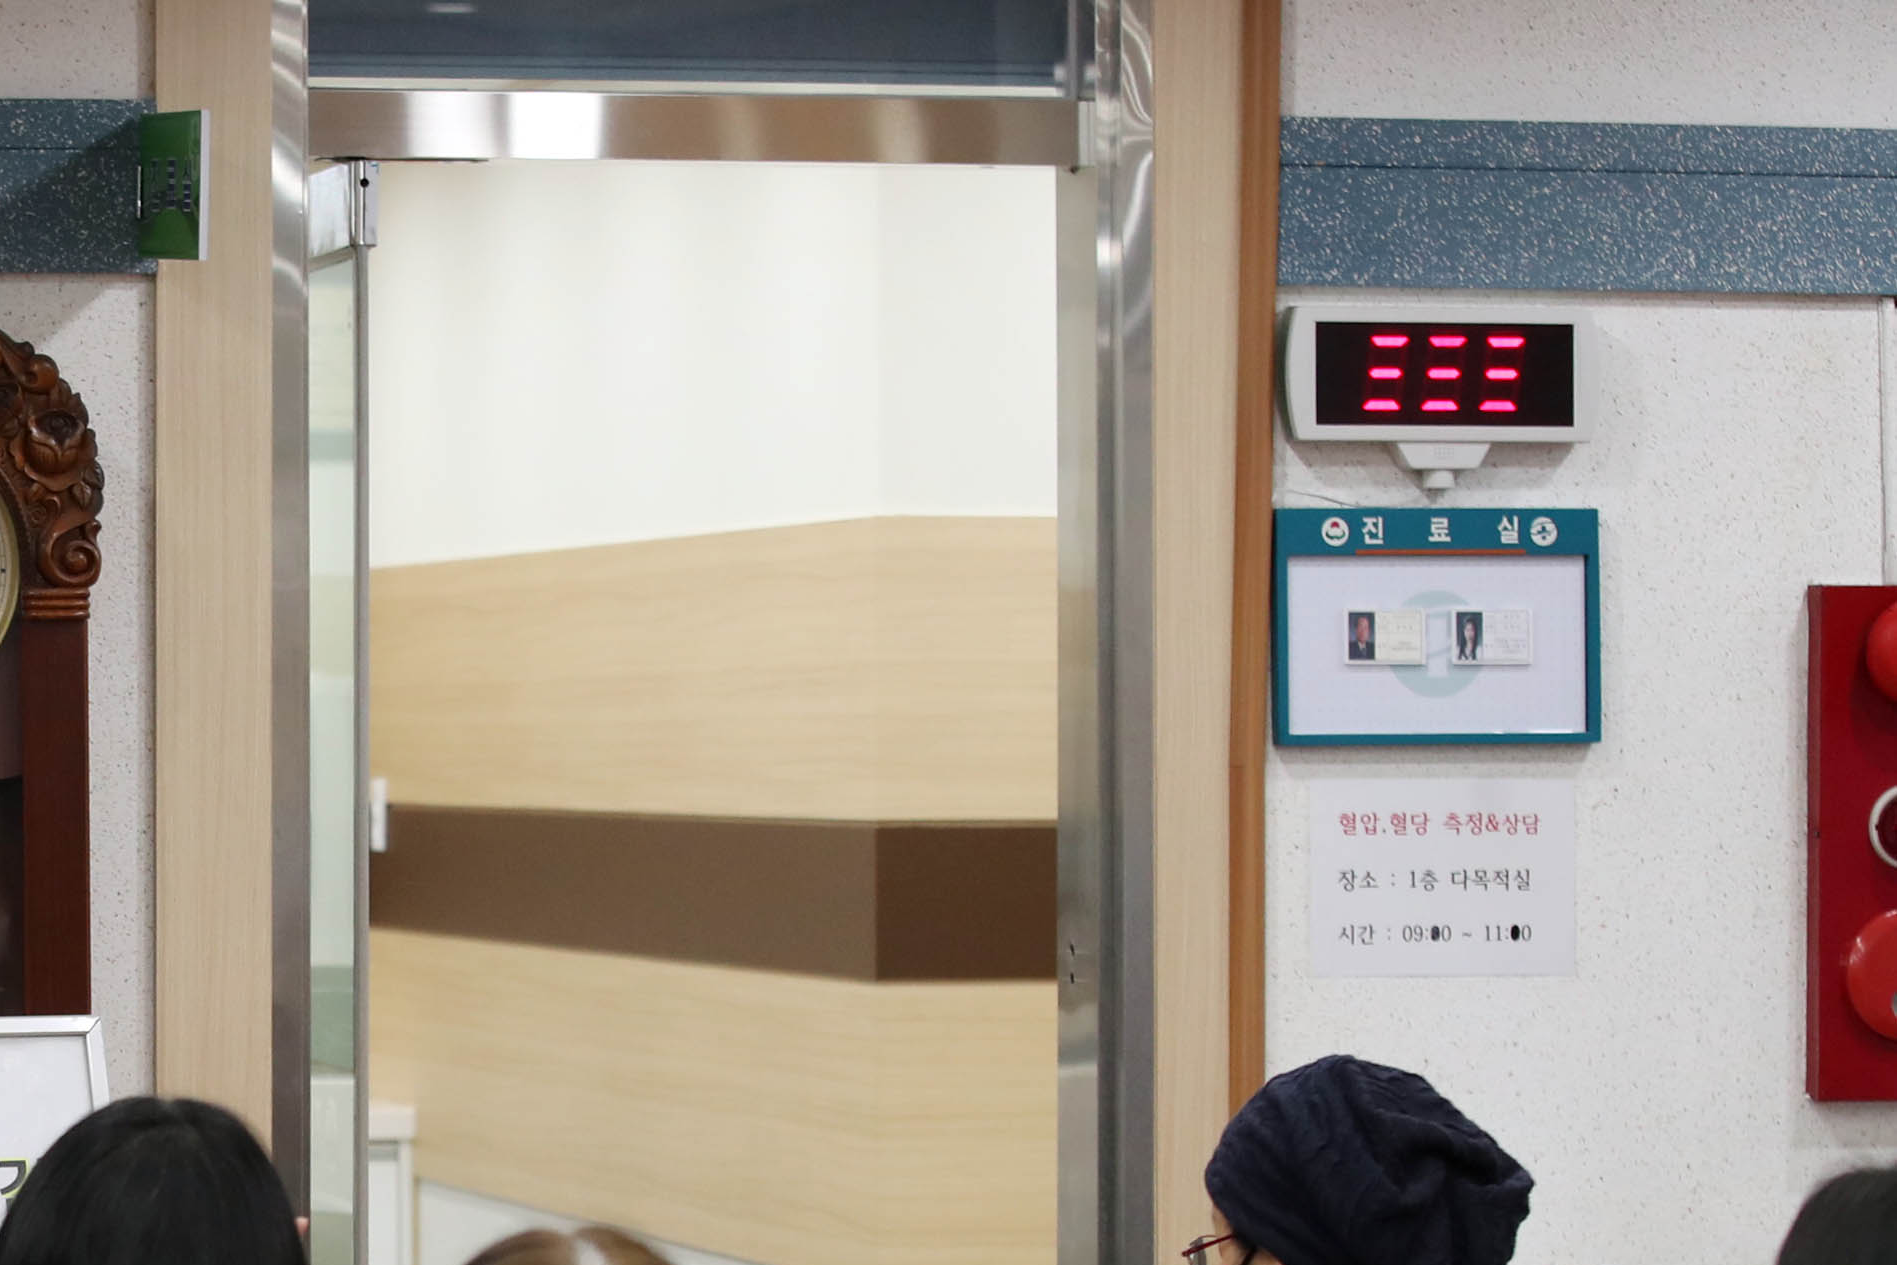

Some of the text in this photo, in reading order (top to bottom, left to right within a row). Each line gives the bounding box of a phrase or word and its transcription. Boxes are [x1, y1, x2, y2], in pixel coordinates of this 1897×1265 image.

[1443, 811, 1540, 837] 측정&상담
[1338, 868, 1379, 892] 장소
[1410, 869, 1439, 892] 1층
[1450, 868, 1531, 892] 다목적실
[1339, 924, 1374, 946] 시간
